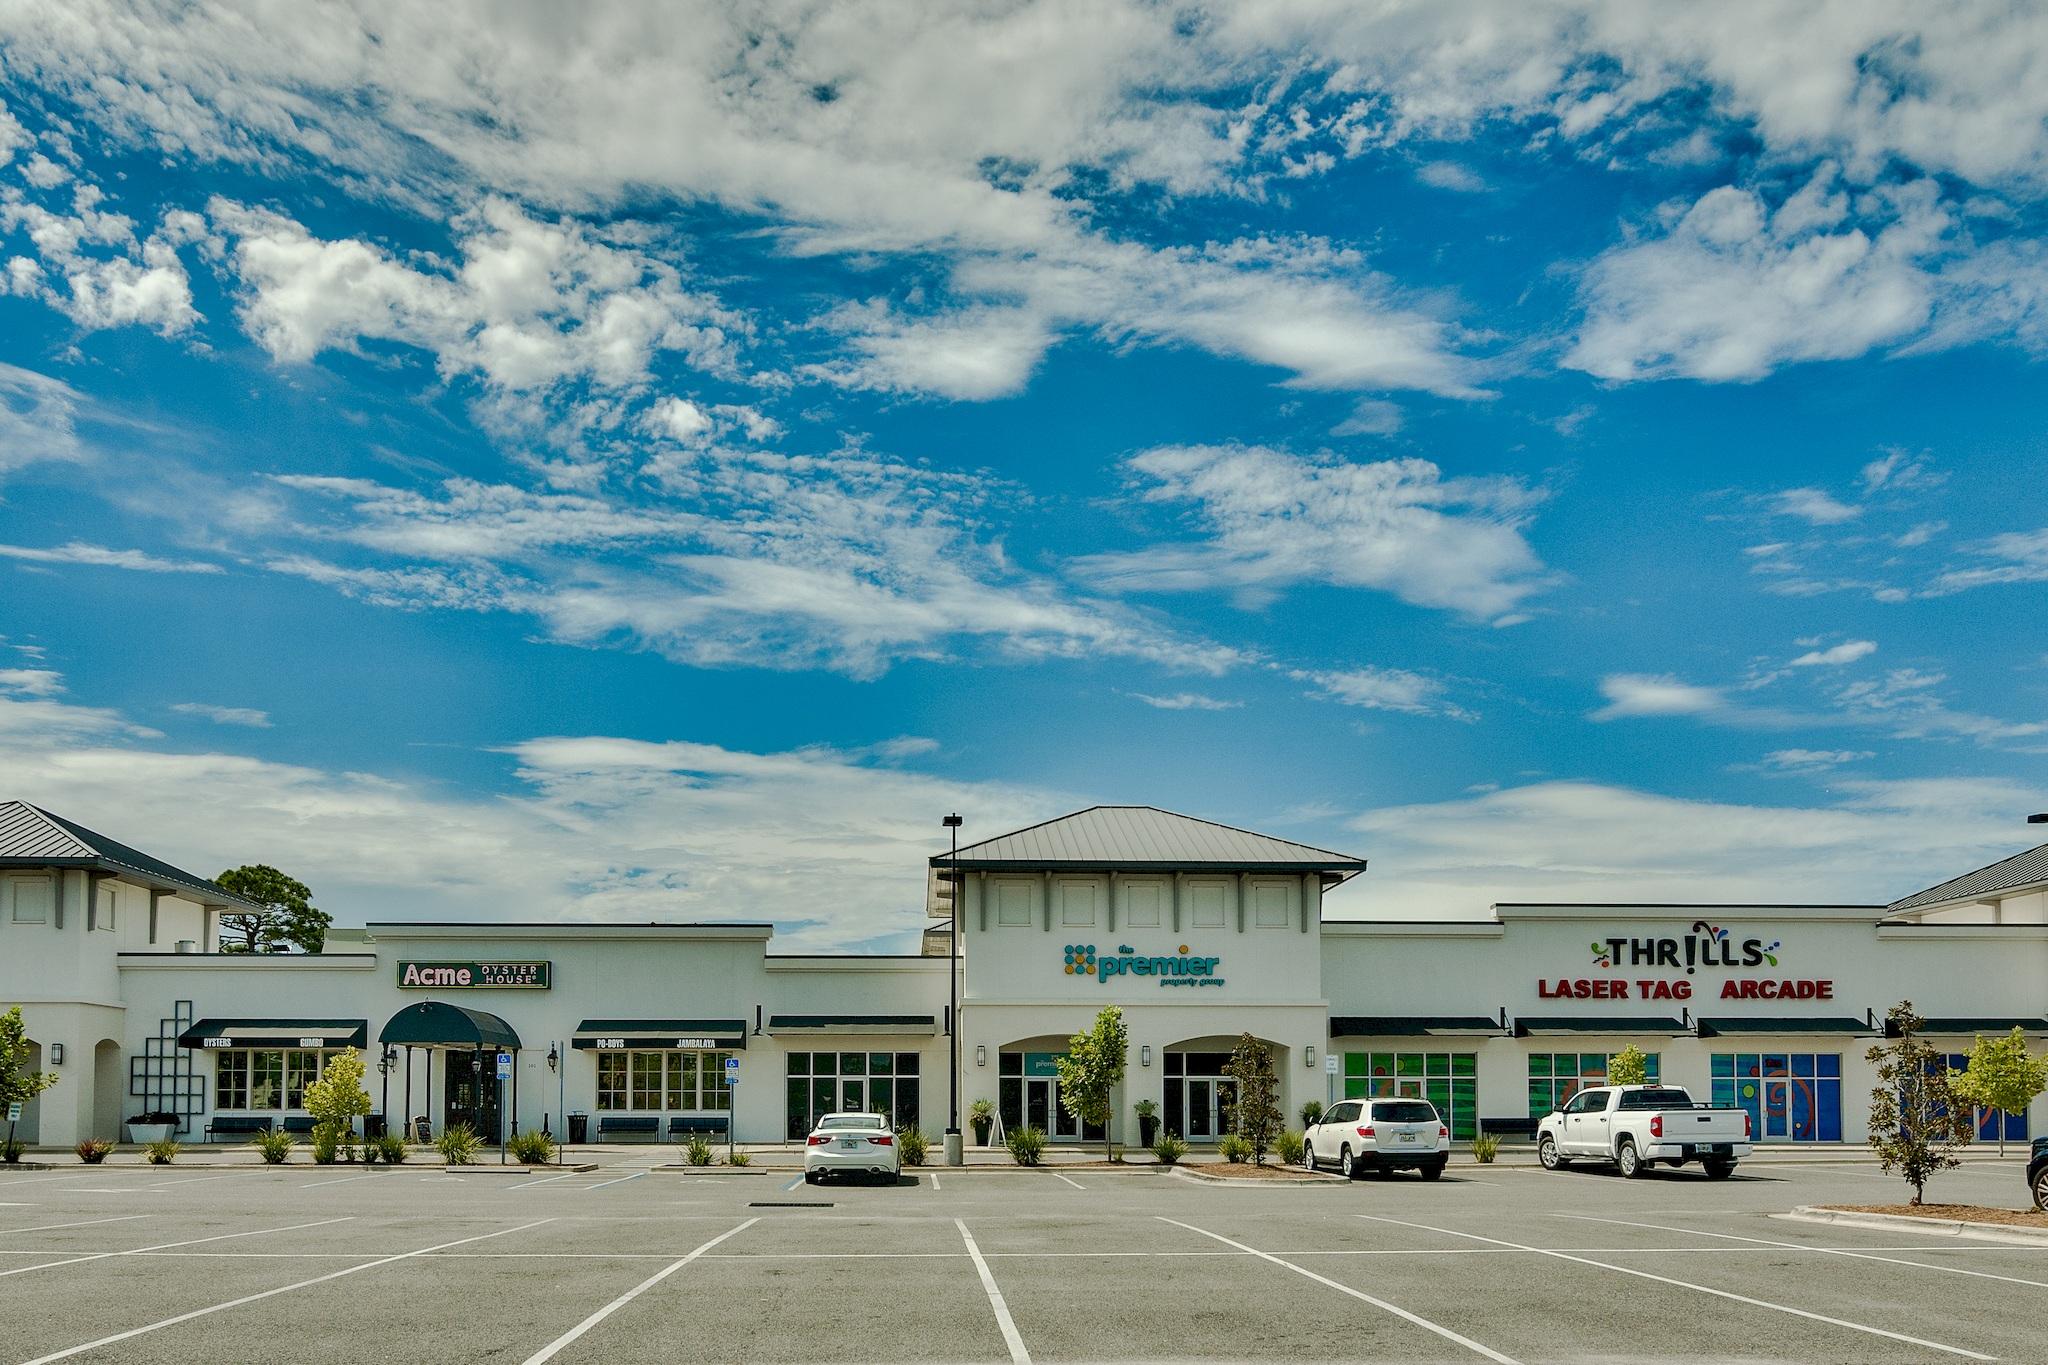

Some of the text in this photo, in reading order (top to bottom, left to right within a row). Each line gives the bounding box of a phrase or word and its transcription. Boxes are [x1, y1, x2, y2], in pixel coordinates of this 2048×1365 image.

[1118, 944, 1135, 954] the
[1098, 944, 1220, 983] premier
[403, 963, 472, 985] Acme
[481, 965, 537, 975] OYSTER
[1160, 977, 1225, 987] property group
[1538, 979, 1834, 999] LASER TAG ARCADE
[203, 1037, 232, 1048] OYSTERS
[299, 1037, 324, 1048] GUMBO
[676, 1038, 716, 1049] JAMBALAYA
